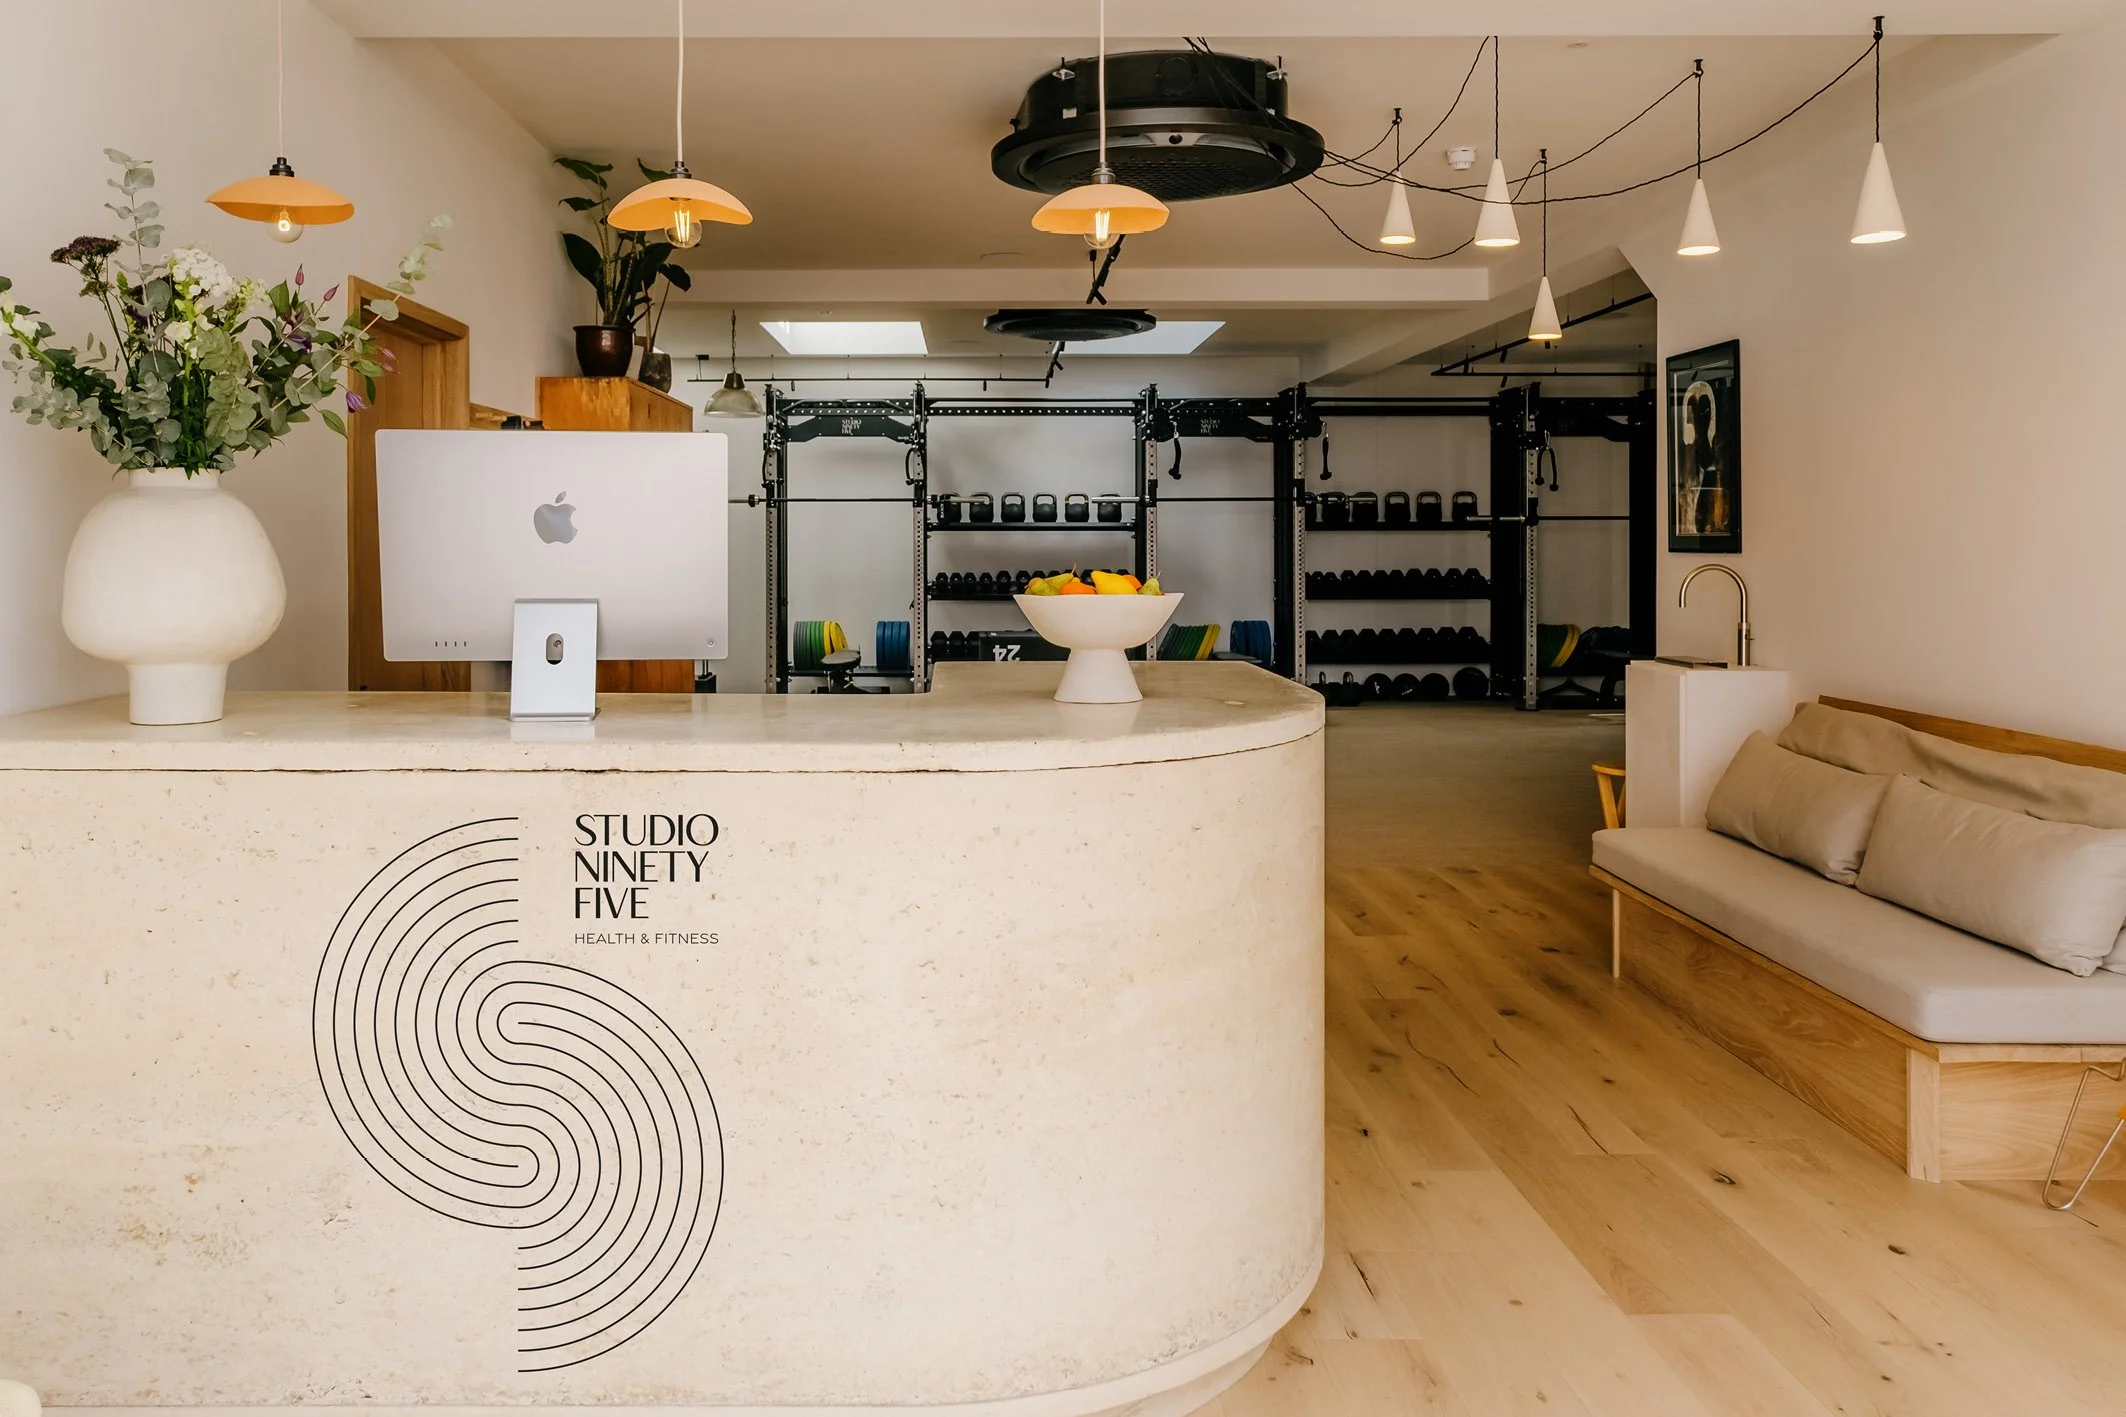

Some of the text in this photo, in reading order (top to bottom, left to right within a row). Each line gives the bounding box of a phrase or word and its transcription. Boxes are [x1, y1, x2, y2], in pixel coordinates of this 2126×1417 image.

[993, 644, 1021, 662] 24
[574, 813, 719, 846] STUDIO
[575, 850, 709, 882] NINETY
[575, 887, 649, 919] FIVE
[574, 933, 719, 944] HEALTH & FITNESS
